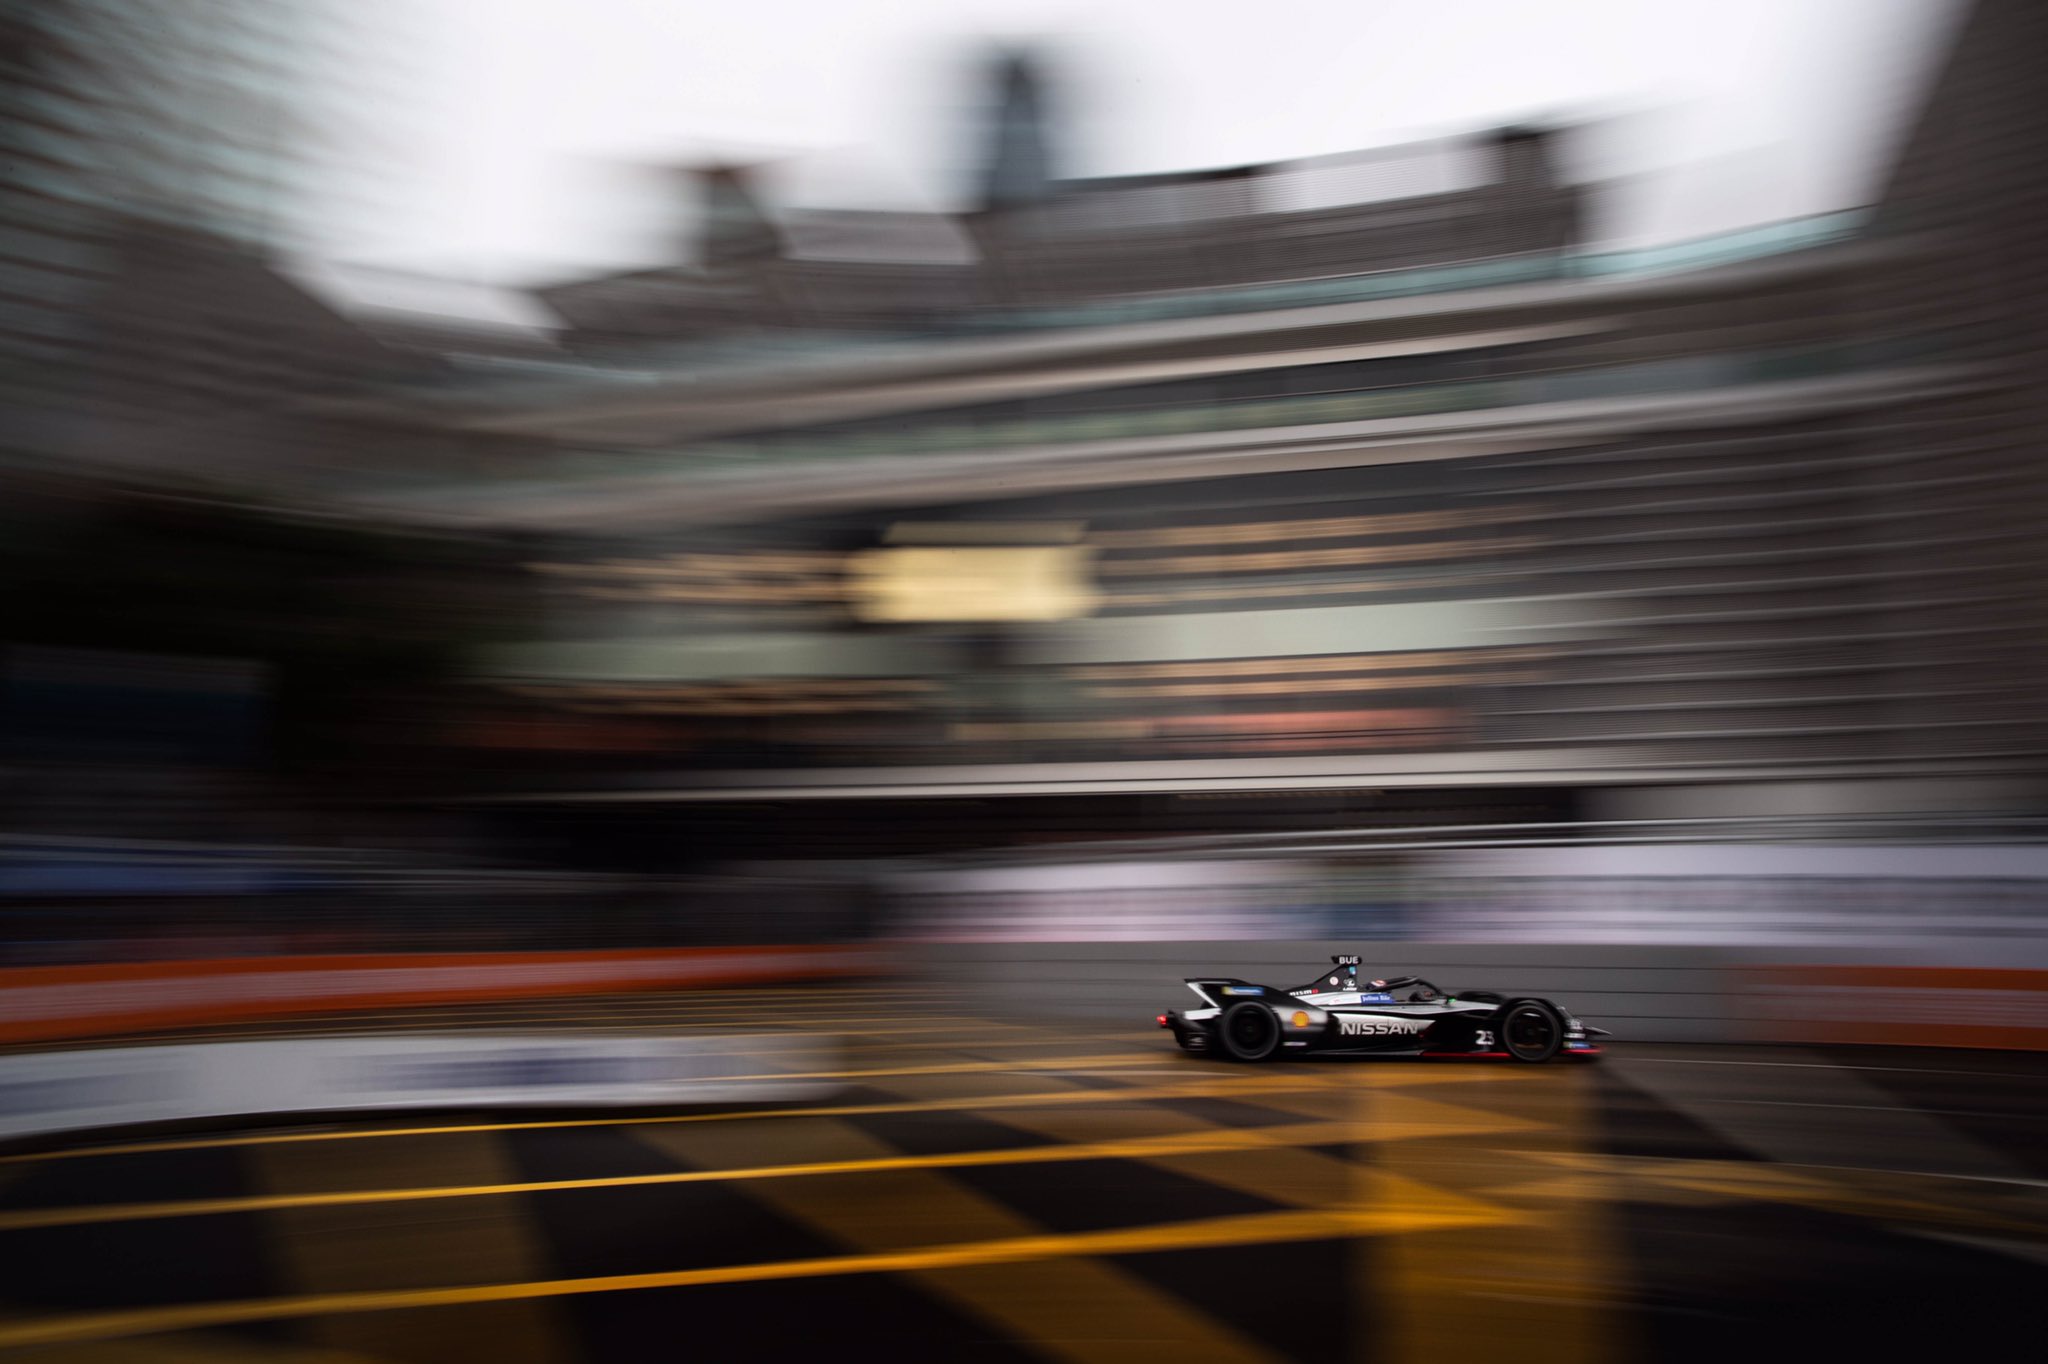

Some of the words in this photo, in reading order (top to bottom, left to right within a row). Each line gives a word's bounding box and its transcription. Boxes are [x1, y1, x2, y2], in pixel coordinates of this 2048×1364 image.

[1339, 956, 1359, 964] BUE
[1340, 1022, 1418, 1035] NISSAN
[1475, 1030, 1495, 1045] 23
